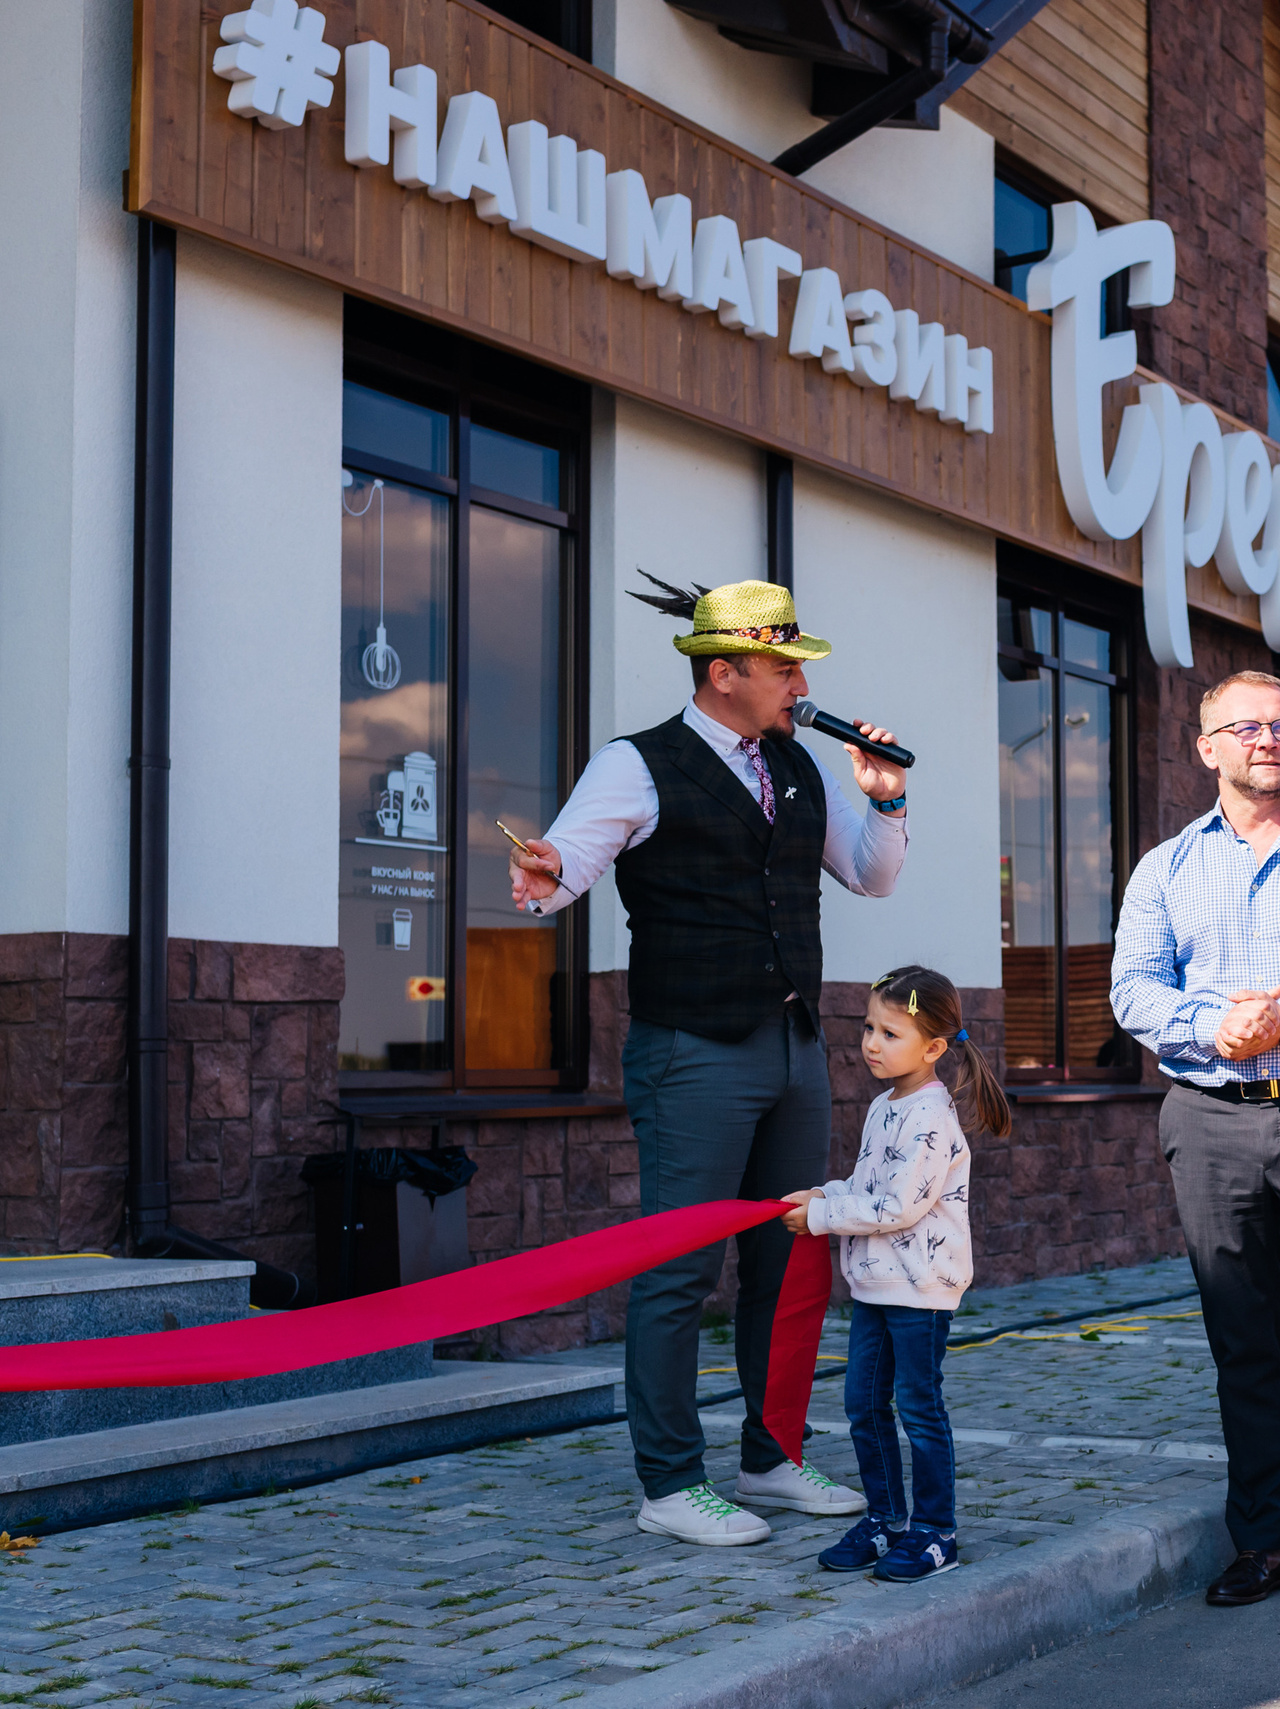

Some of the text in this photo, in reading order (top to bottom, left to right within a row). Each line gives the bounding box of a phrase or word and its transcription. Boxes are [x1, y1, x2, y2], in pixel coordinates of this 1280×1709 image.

[371, 866, 435, 882] ВКУСНЫЙ КОФЕ
[371, 884, 377, 894] У
[378, 885, 393, 896] НАС
[399, 886, 409, 896] НА
[410, 887, 435, 899] ВЫНОС
